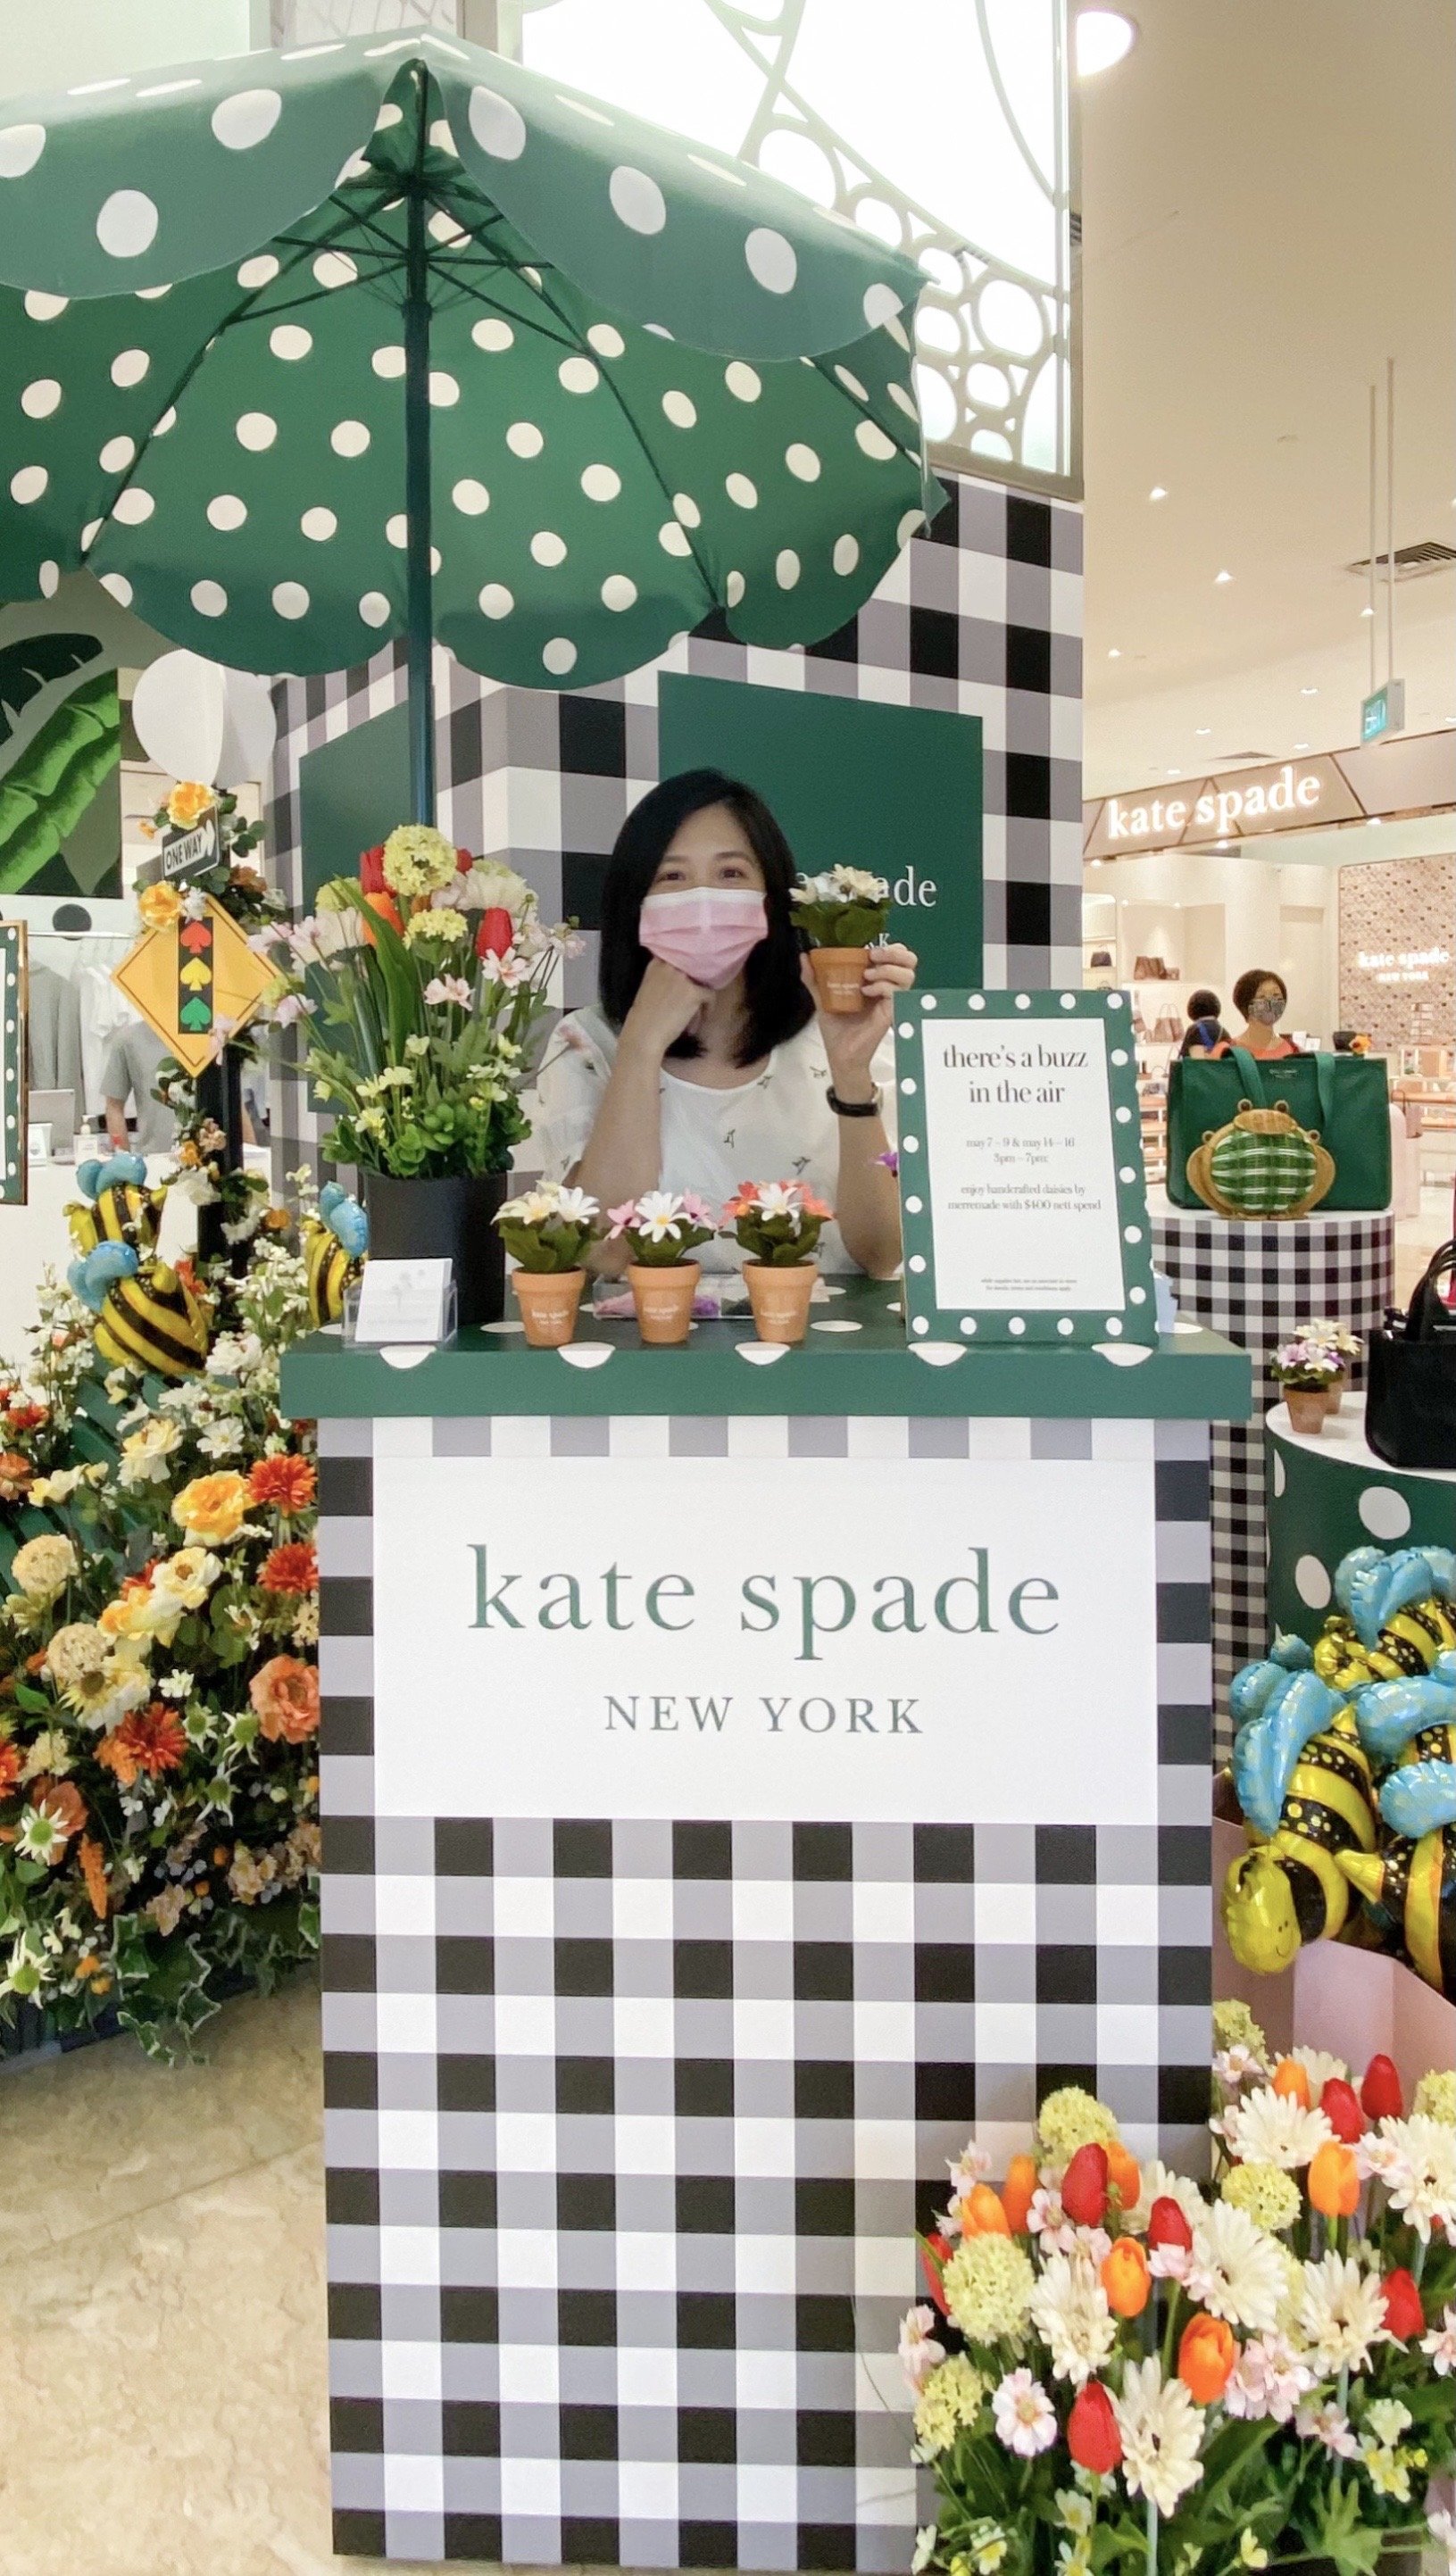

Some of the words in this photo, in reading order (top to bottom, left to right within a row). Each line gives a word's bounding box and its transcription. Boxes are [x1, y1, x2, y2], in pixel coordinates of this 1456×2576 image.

[1108, 800, 1186, 839] kate
[1195, 766, 1321, 835] spade
[166, 843, 183, 869] ONE
[184, 833, 203, 860] WAY
[1358, 951, 1394, 968] kate
[1398, 946, 1450, 969] spade
[944, 1044, 1017, 1068] there's
[1021, 1051, 1033, 1068] a
[1037, 1044, 1088, 1068] buzz
[969, 1081, 990, 1102] in
[996, 1079, 1032, 1103] the
[1036, 1081, 1065, 1103] air
[966, 1139, 984, 1150] may
[986, 1137, 993, 1148] 7
[1003, 1137, 1010, 1148] 9
[1011, 1137, 1020, 1148] &
[1022, 1139, 1041, 1150] may
[1044, 1137, 1053, 1148] 14
[1064, 1137, 1075, 1148] 16
[994, 1152, 1015, 1165] 3pm
[961, 1185, 984, 1196] enjoy
[986, 1184, 1040, 1194] handcrafted
[1043, 1184, 1072, 1194] daisies
[1074, 1184, 1086, 1196] by
[1002, 1200, 1022, 1209] with
[1053, 1200, 1071, 1209] nett
[1073, 1199, 1101, 1212] spend
[466, 1543, 696, 1631] kate
[740, 1547, 1061, 1660] spade
[603, 1695, 734, 1732] NEW
[760, 1697, 924, 1734] YORK
